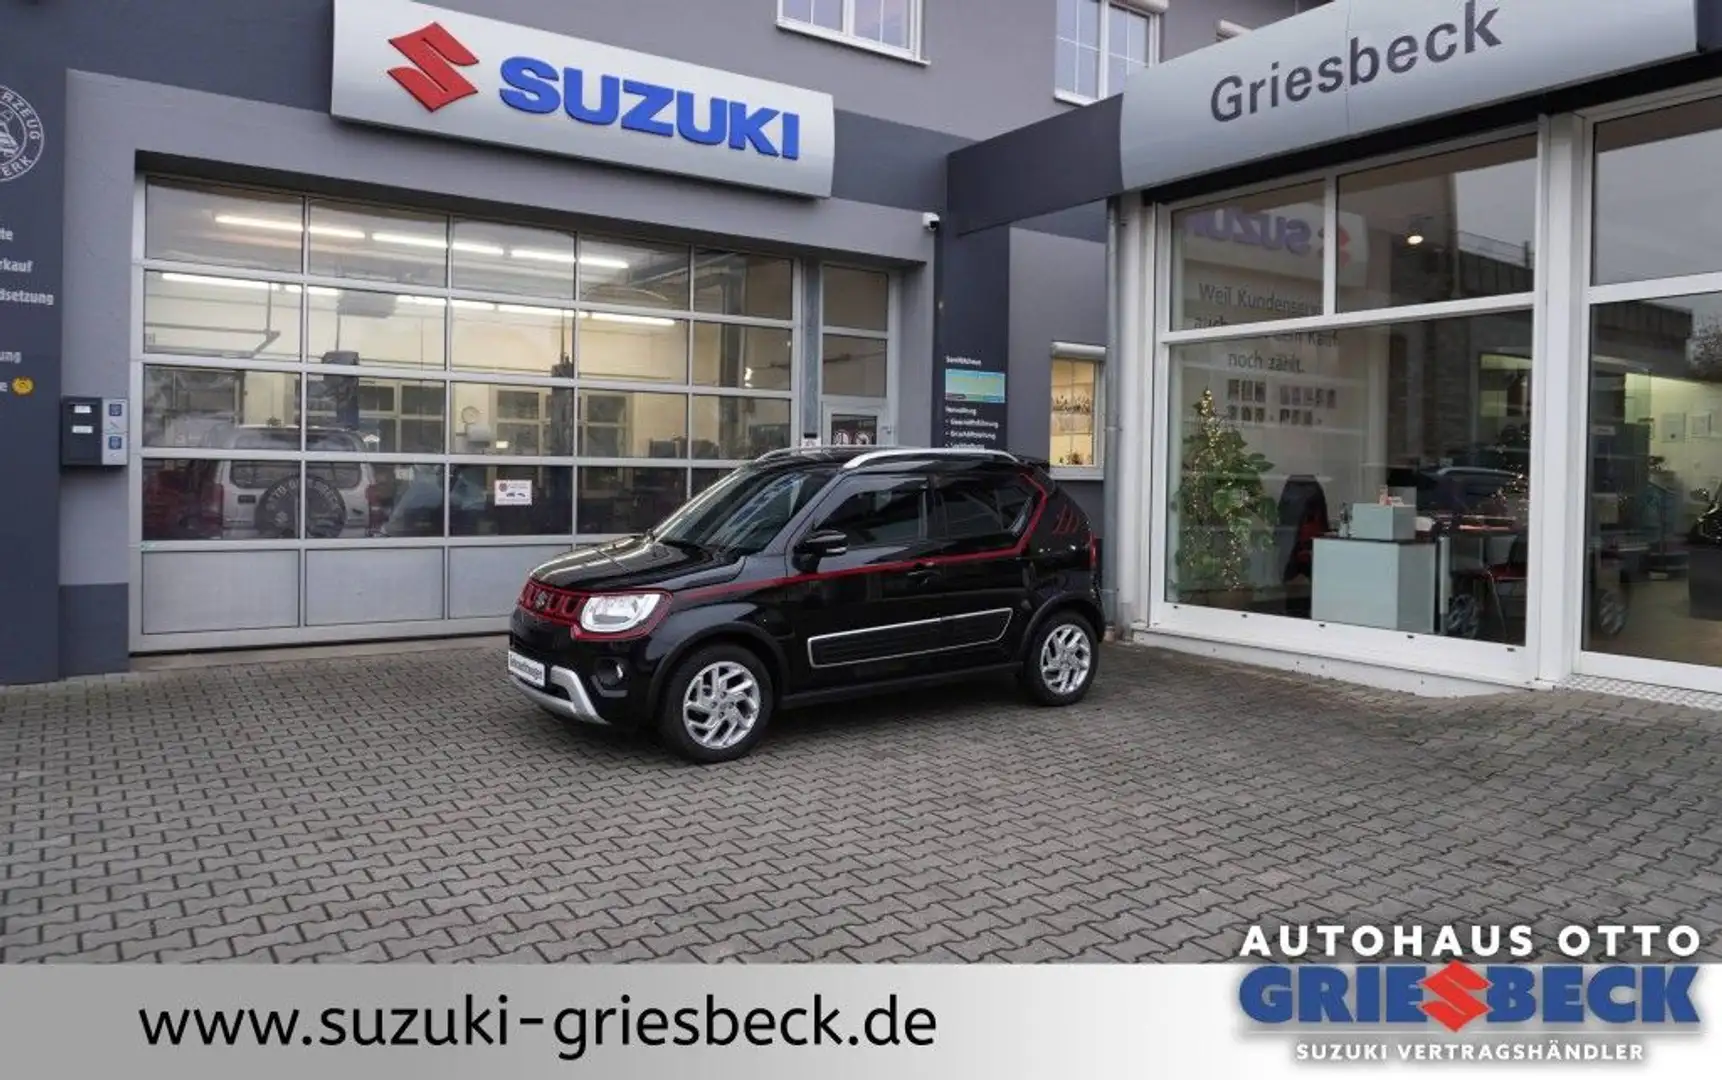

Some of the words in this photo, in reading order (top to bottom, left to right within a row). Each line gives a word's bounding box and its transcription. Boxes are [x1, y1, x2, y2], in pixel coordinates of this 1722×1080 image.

[1211, 0, 1502, 123] Griesbeck
[498, 56, 800, 160] SUZUKI
[1198, 282, 1232, 306] Weil
[1227, 350, 1263, 369] noch
